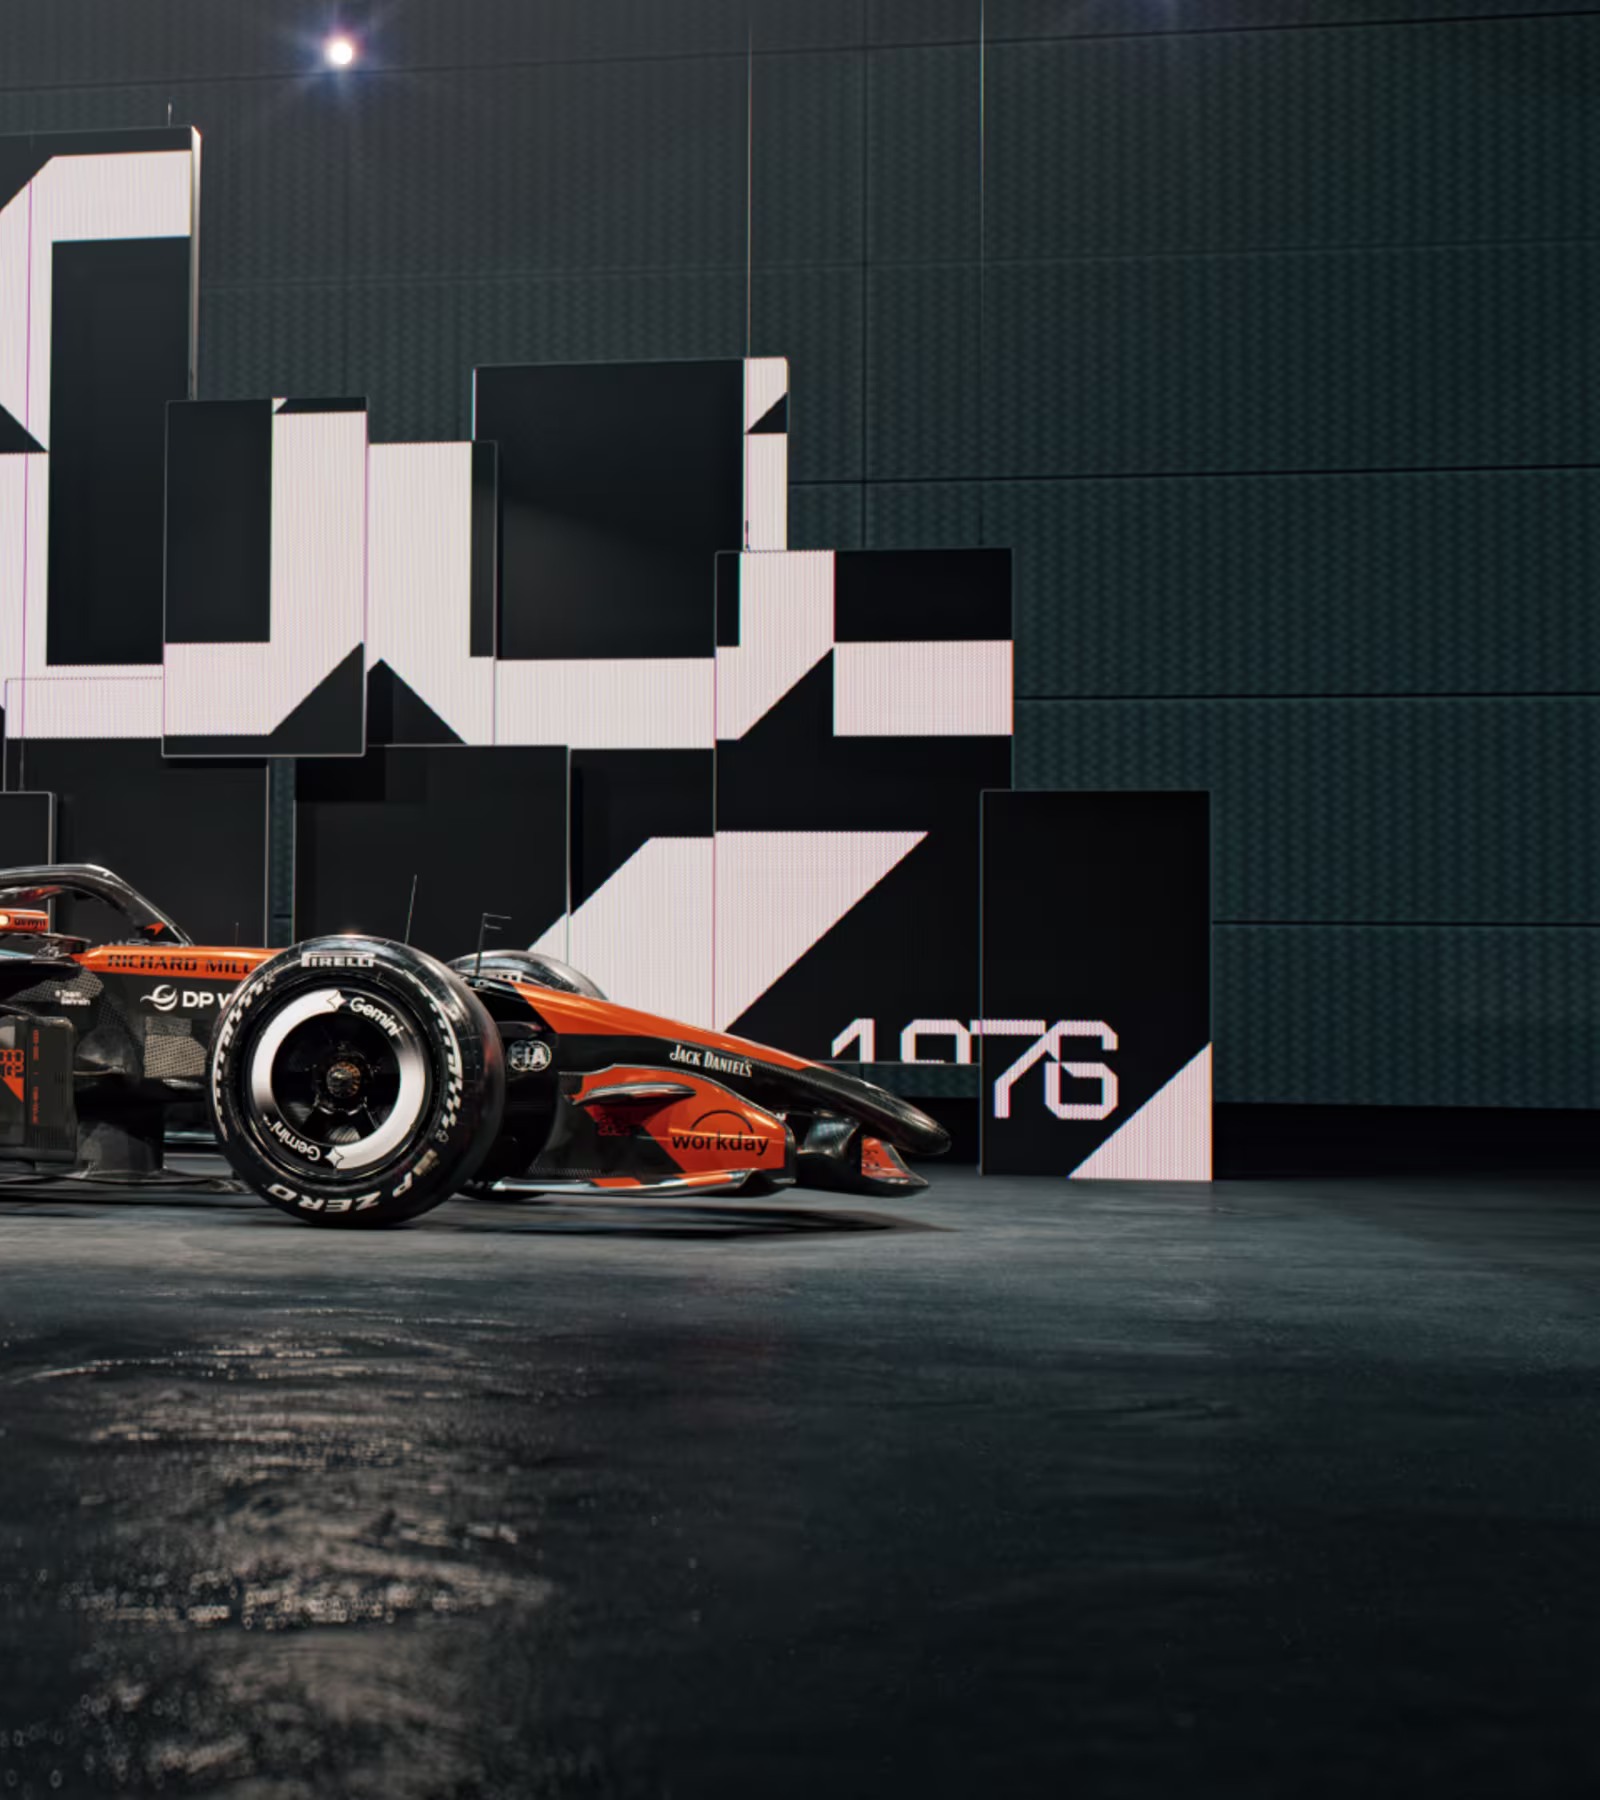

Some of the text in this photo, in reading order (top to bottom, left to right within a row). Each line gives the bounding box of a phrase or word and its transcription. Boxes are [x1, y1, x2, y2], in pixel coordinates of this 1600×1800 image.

[107, 954, 266, 974] RICHARD MILL
[301, 952, 376, 967] PIRELLI
[182, 991, 214, 1008] DP
[350, 997, 404, 1037] Gemini
[510, 1047, 547, 1067] FIA
[271, 1121, 321, 1161] Gemini
[671, 1132, 769, 1157] workday
[268, 1183, 382, 1213] ZERO
